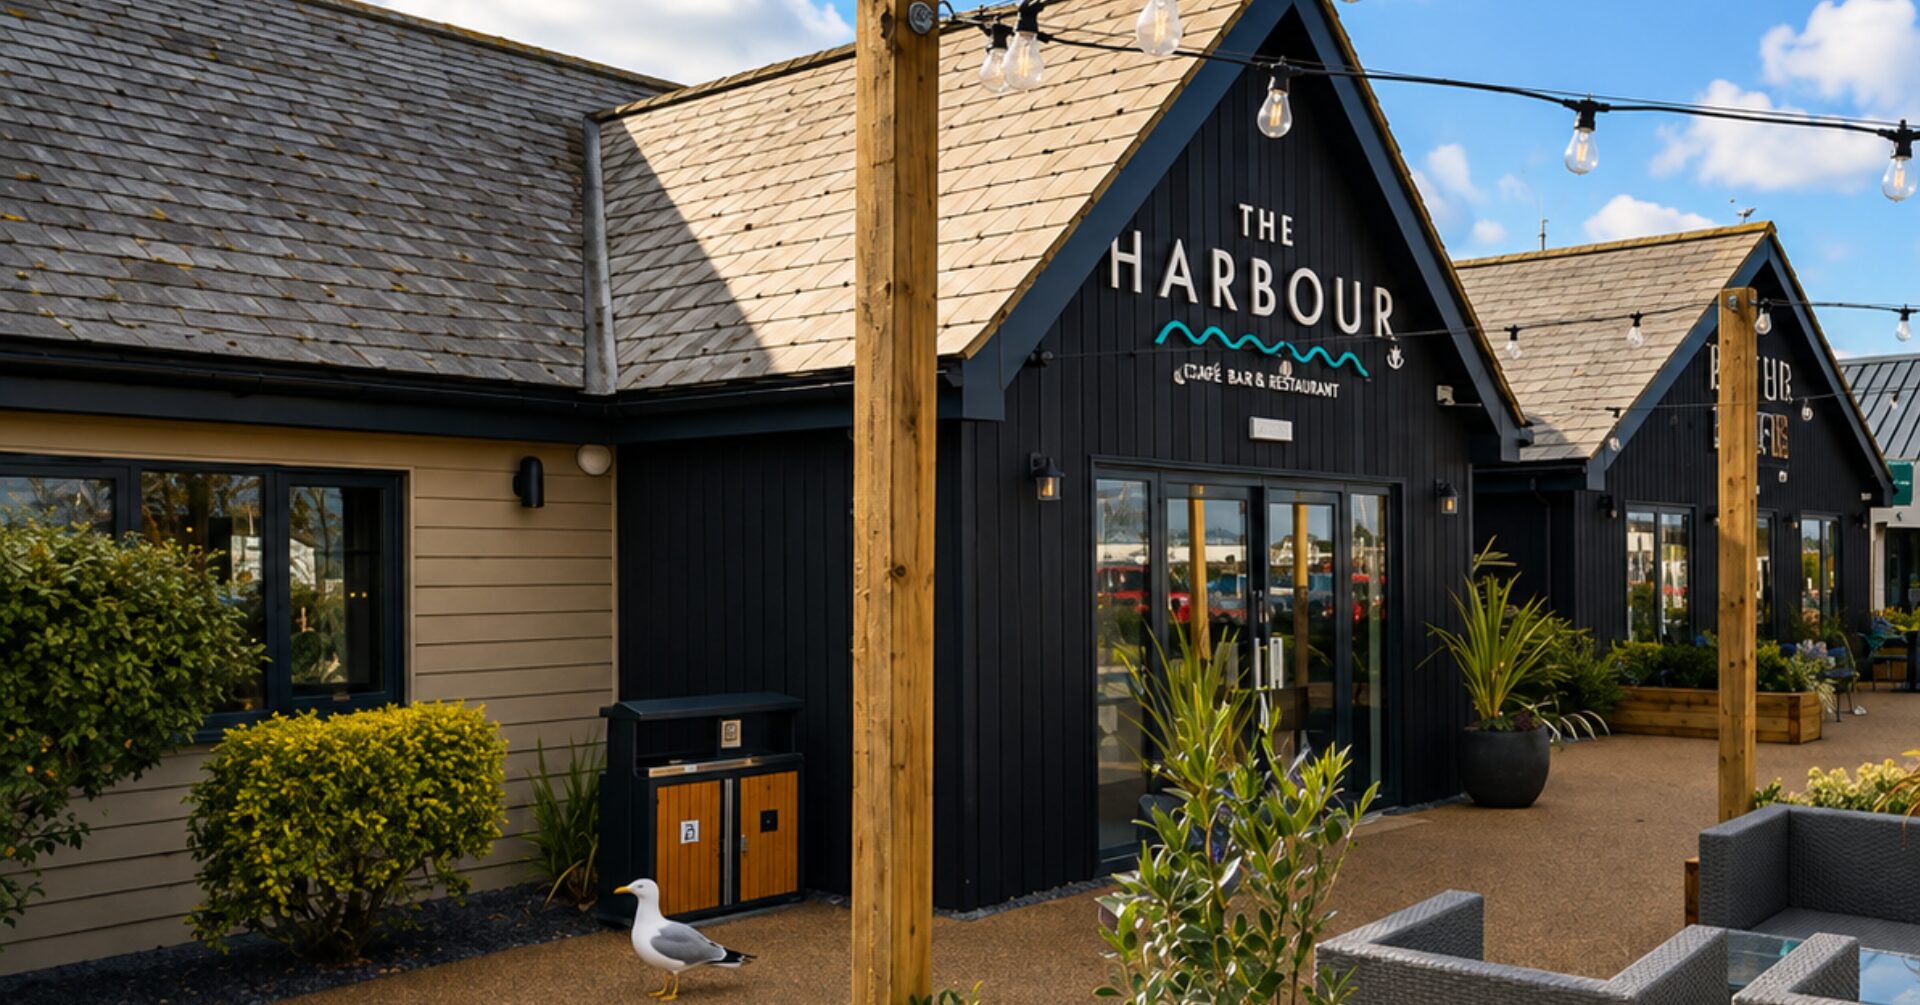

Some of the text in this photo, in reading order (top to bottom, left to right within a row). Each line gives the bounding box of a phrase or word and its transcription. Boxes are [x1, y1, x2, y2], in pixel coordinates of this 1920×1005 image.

[1239, 203, 1293, 246] THE
[1110, 230, 1394, 338] HARBOUR
[1227, 369, 1251, 386] BAR
[1255, 372, 1265, 388] &
[1268, 375, 1340, 398] RESTAURANT
